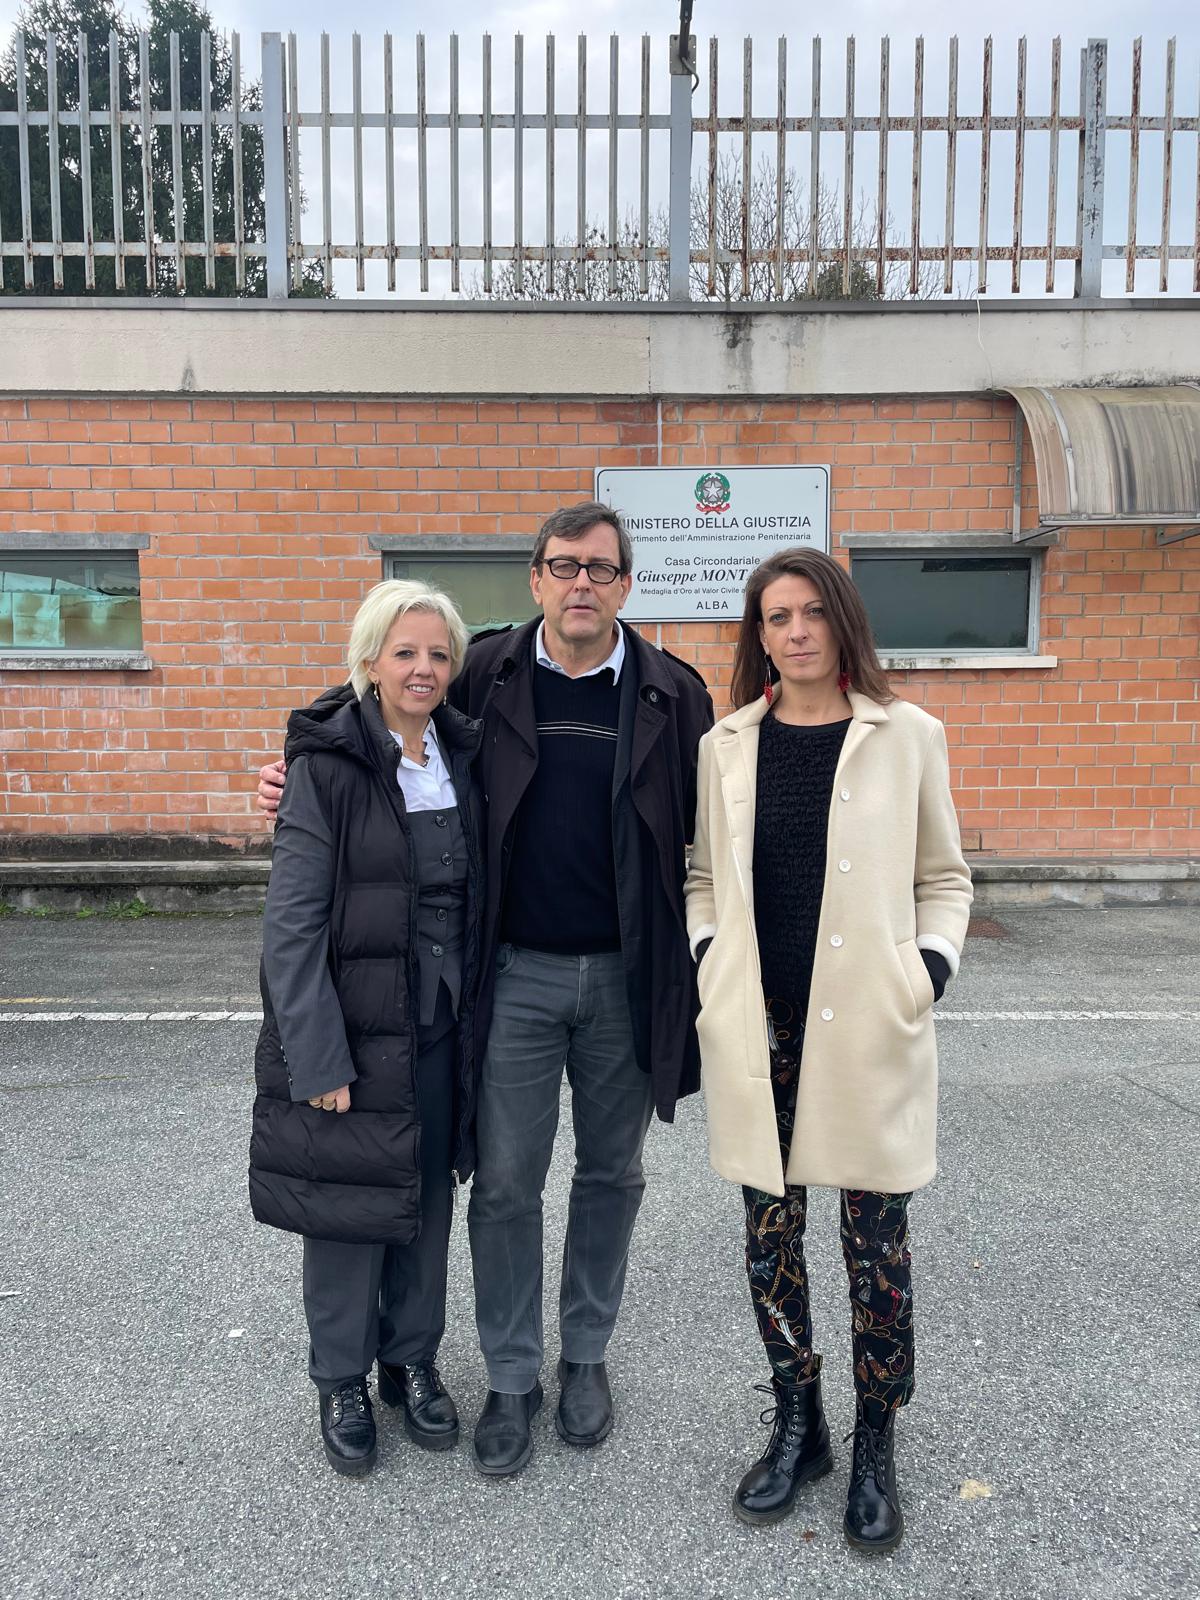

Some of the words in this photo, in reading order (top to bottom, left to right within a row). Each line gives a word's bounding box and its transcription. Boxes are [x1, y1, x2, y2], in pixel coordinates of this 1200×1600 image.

[623, 518, 691, 529] INISTERO
[695, 517, 740, 529] DELLA
[743, 516, 812, 528] GIUSTIZIA
[670, 534, 755, 542] dell'Amministrazione
[758, 532, 811, 541] Penitenziaria
[664, 557, 691, 566] Casa
[693, 556, 761, 566] Circondariale
[637, 570, 697, 585] Giuseppe
[700, 569, 749, 582] MONT
[673, 587, 693, 595] d'Oro
[696, 600, 729, 610] ALBA
